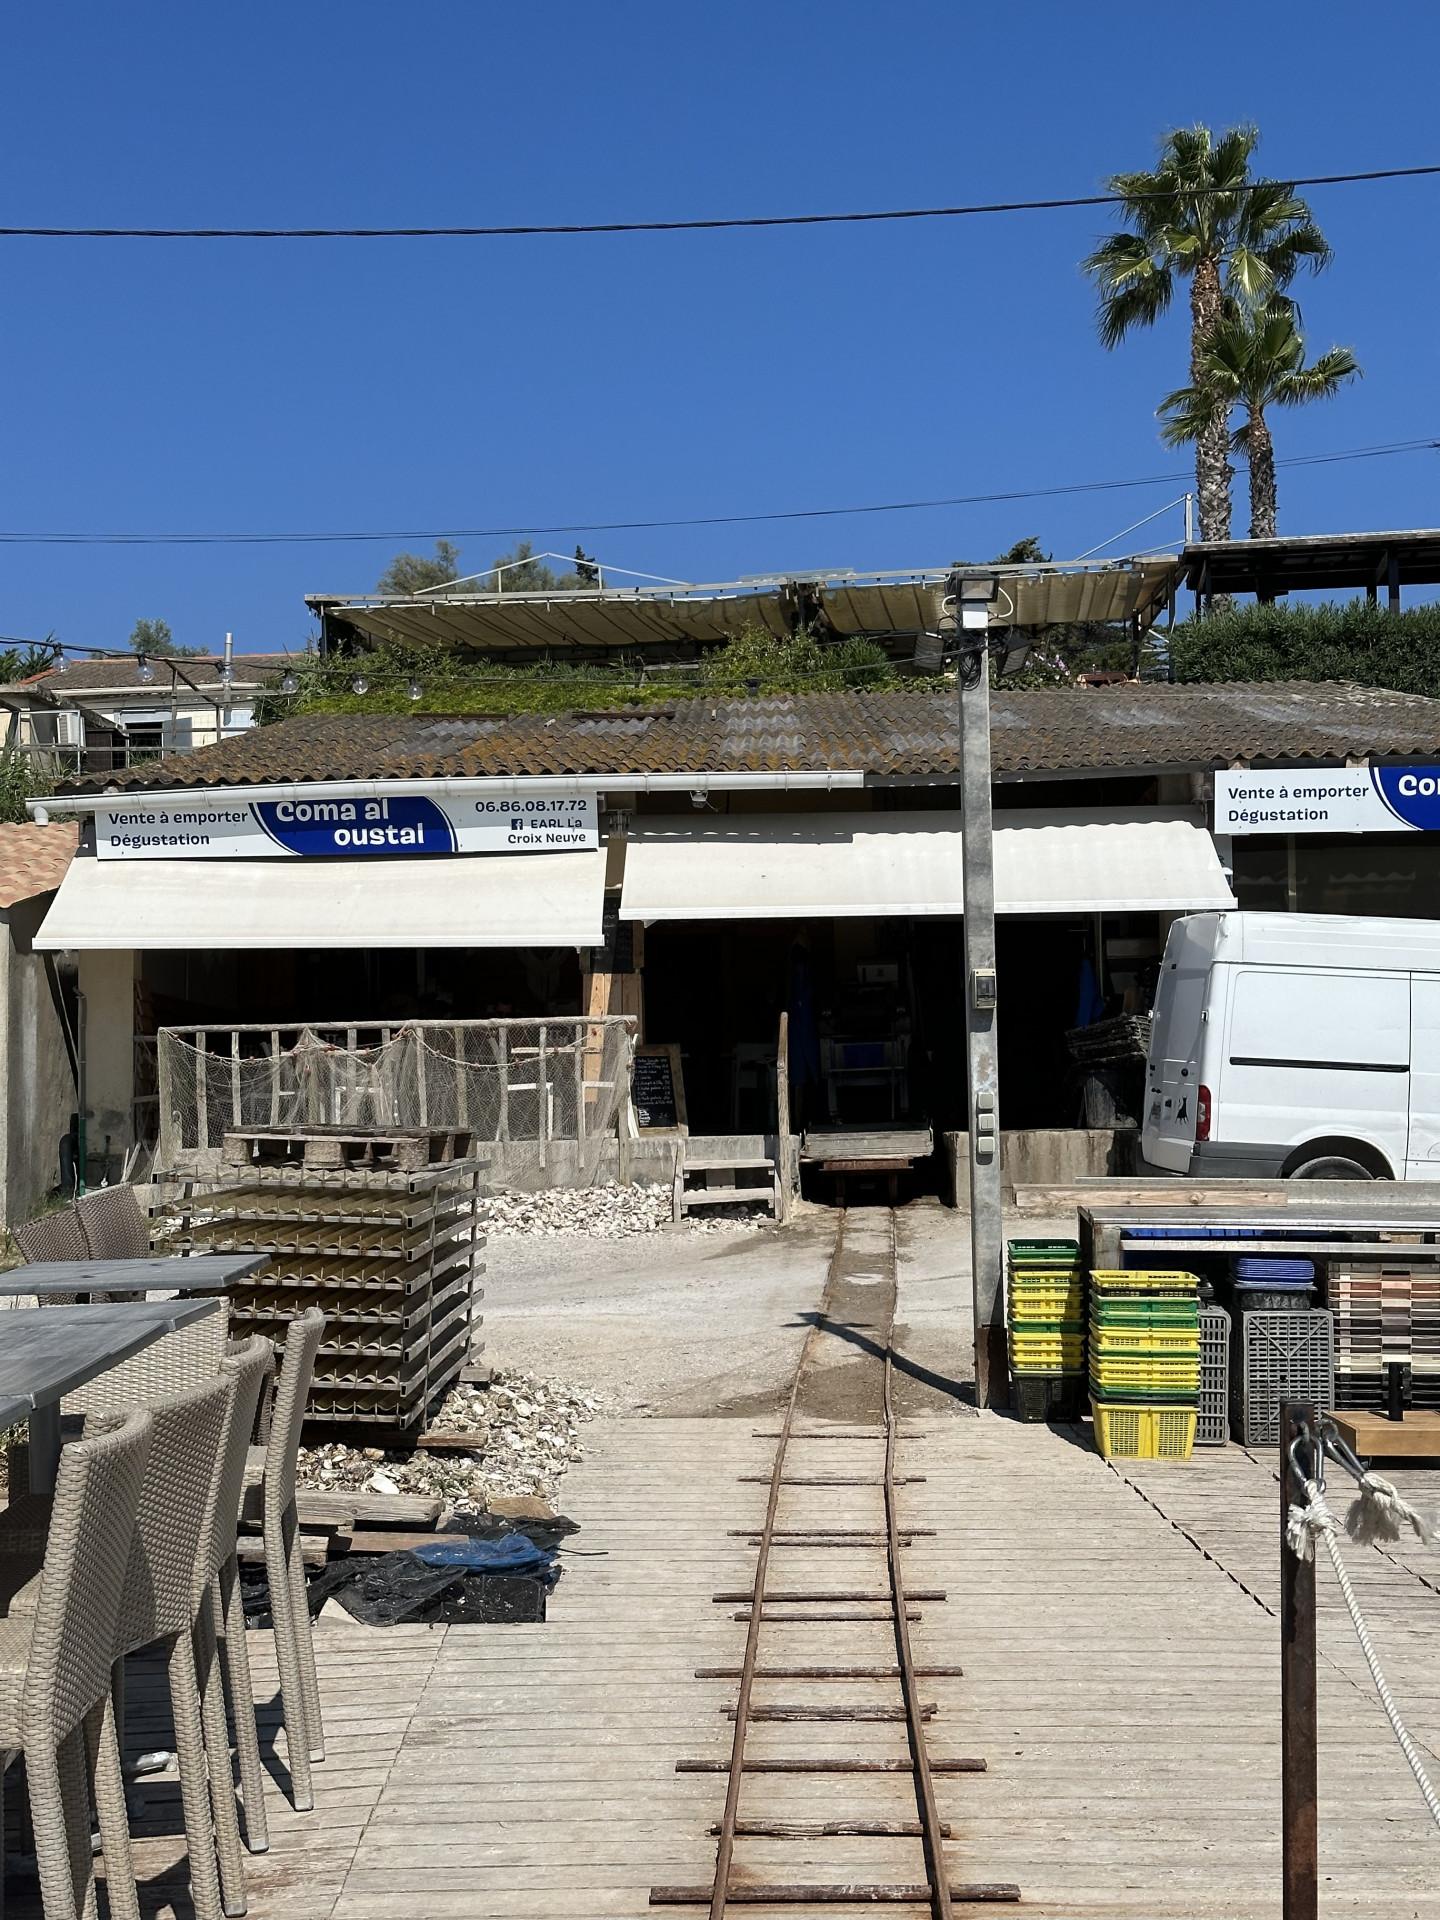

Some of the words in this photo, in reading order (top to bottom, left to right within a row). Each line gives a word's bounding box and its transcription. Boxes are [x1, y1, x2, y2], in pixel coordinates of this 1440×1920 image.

[1229, 787, 1274, 800] Vente
[1280, 786, 1288, 798] à
[1293, 785, 1370, 801] emporter
[1398, 774, 1440, 796] Co
[276, 801, 357, 822] Coma
[364, 798, 389, 819] al
[476, 799, 587, 813] 06.86.08.17.72
[109, 812, 156, 825] Vente
[160, 811, 168, 823] à
[174, 811, 249, 826] emporter
[531, 818, 564, 829] EARL
[568, 819, 582, 829] La
[1229, 808, 1329, 825] Dégustation
[111, 833, 210, 849] Dégustation
[334, 822, 425, 846] oustal
[508, 833, 543, 844] Croix
[547, 833, 586, 843] Neuve
